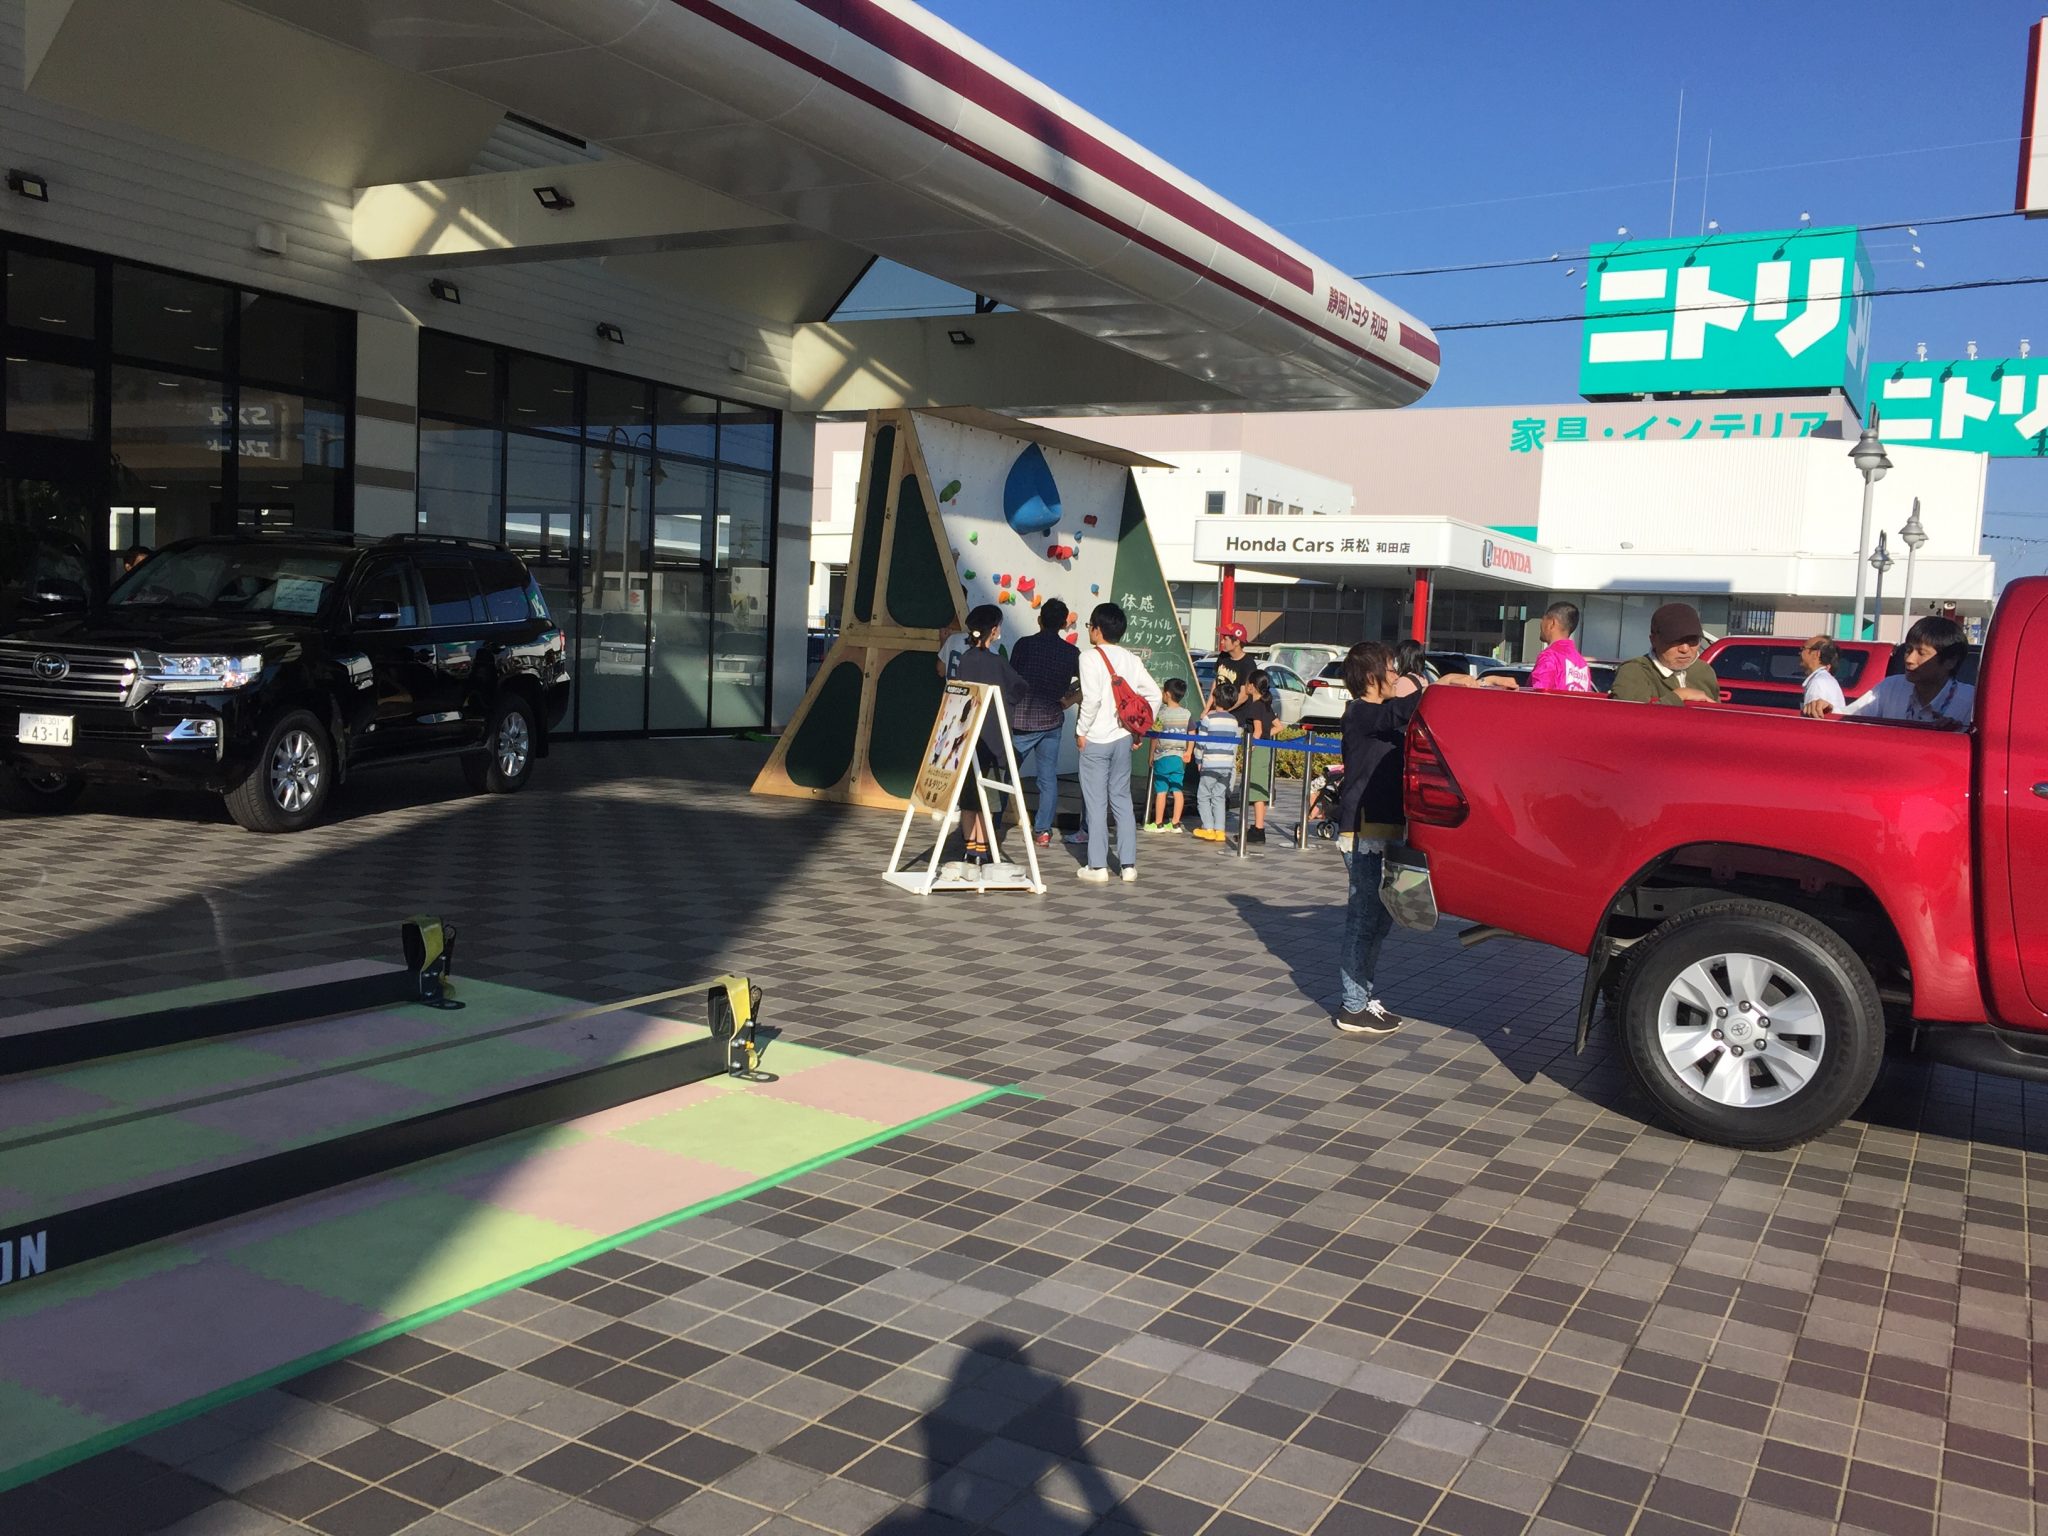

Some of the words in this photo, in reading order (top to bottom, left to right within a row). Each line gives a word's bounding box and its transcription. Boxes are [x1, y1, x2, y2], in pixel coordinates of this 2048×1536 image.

[1326, 286, 1370, 328] 静岡トヨタ
[1370, 311, 1389, 343] 和田
[1588, 257, 1846, 364] ニトリ
[1226, 536, 1287, 552] Honda
[1292, 537, 1335, 553] Cars
[1340, 537, 1370, 553] 浜松
[1376, 541, 1411, 555] 和田店
[1492, 546, 1533, 574] HONDA
[1120, 592, 1155, 613] 体感
[1128, 615, 1173, 631] スティバル
[1121, 630, 1177, 646] ルダリング
[31, 725, 69, 743] 43-14
